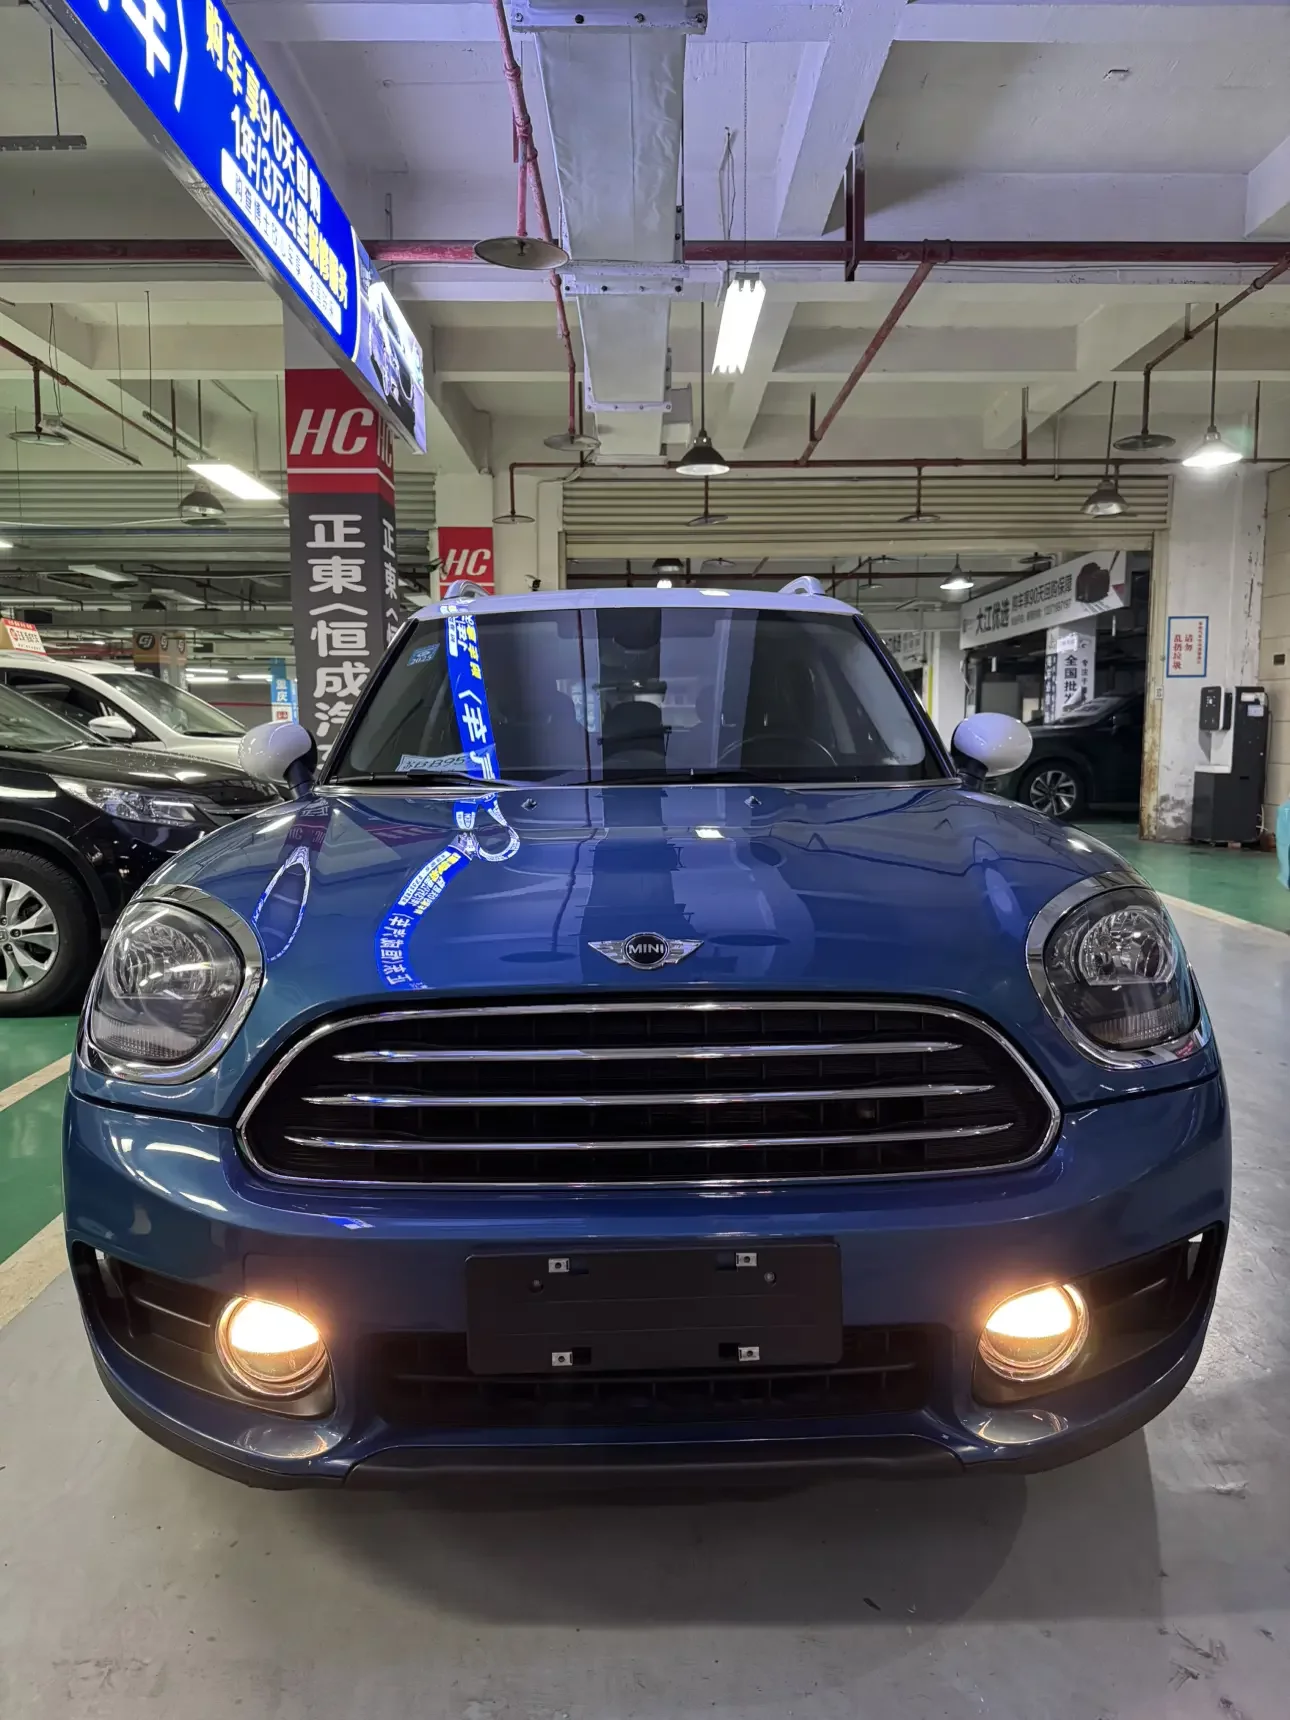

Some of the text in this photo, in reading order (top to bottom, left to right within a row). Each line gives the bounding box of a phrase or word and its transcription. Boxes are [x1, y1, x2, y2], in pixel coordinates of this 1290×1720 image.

[289, 408, 374, 455] HC
[444, 548, 491, 580] HC
[628, 943, 664, 954] MINI
